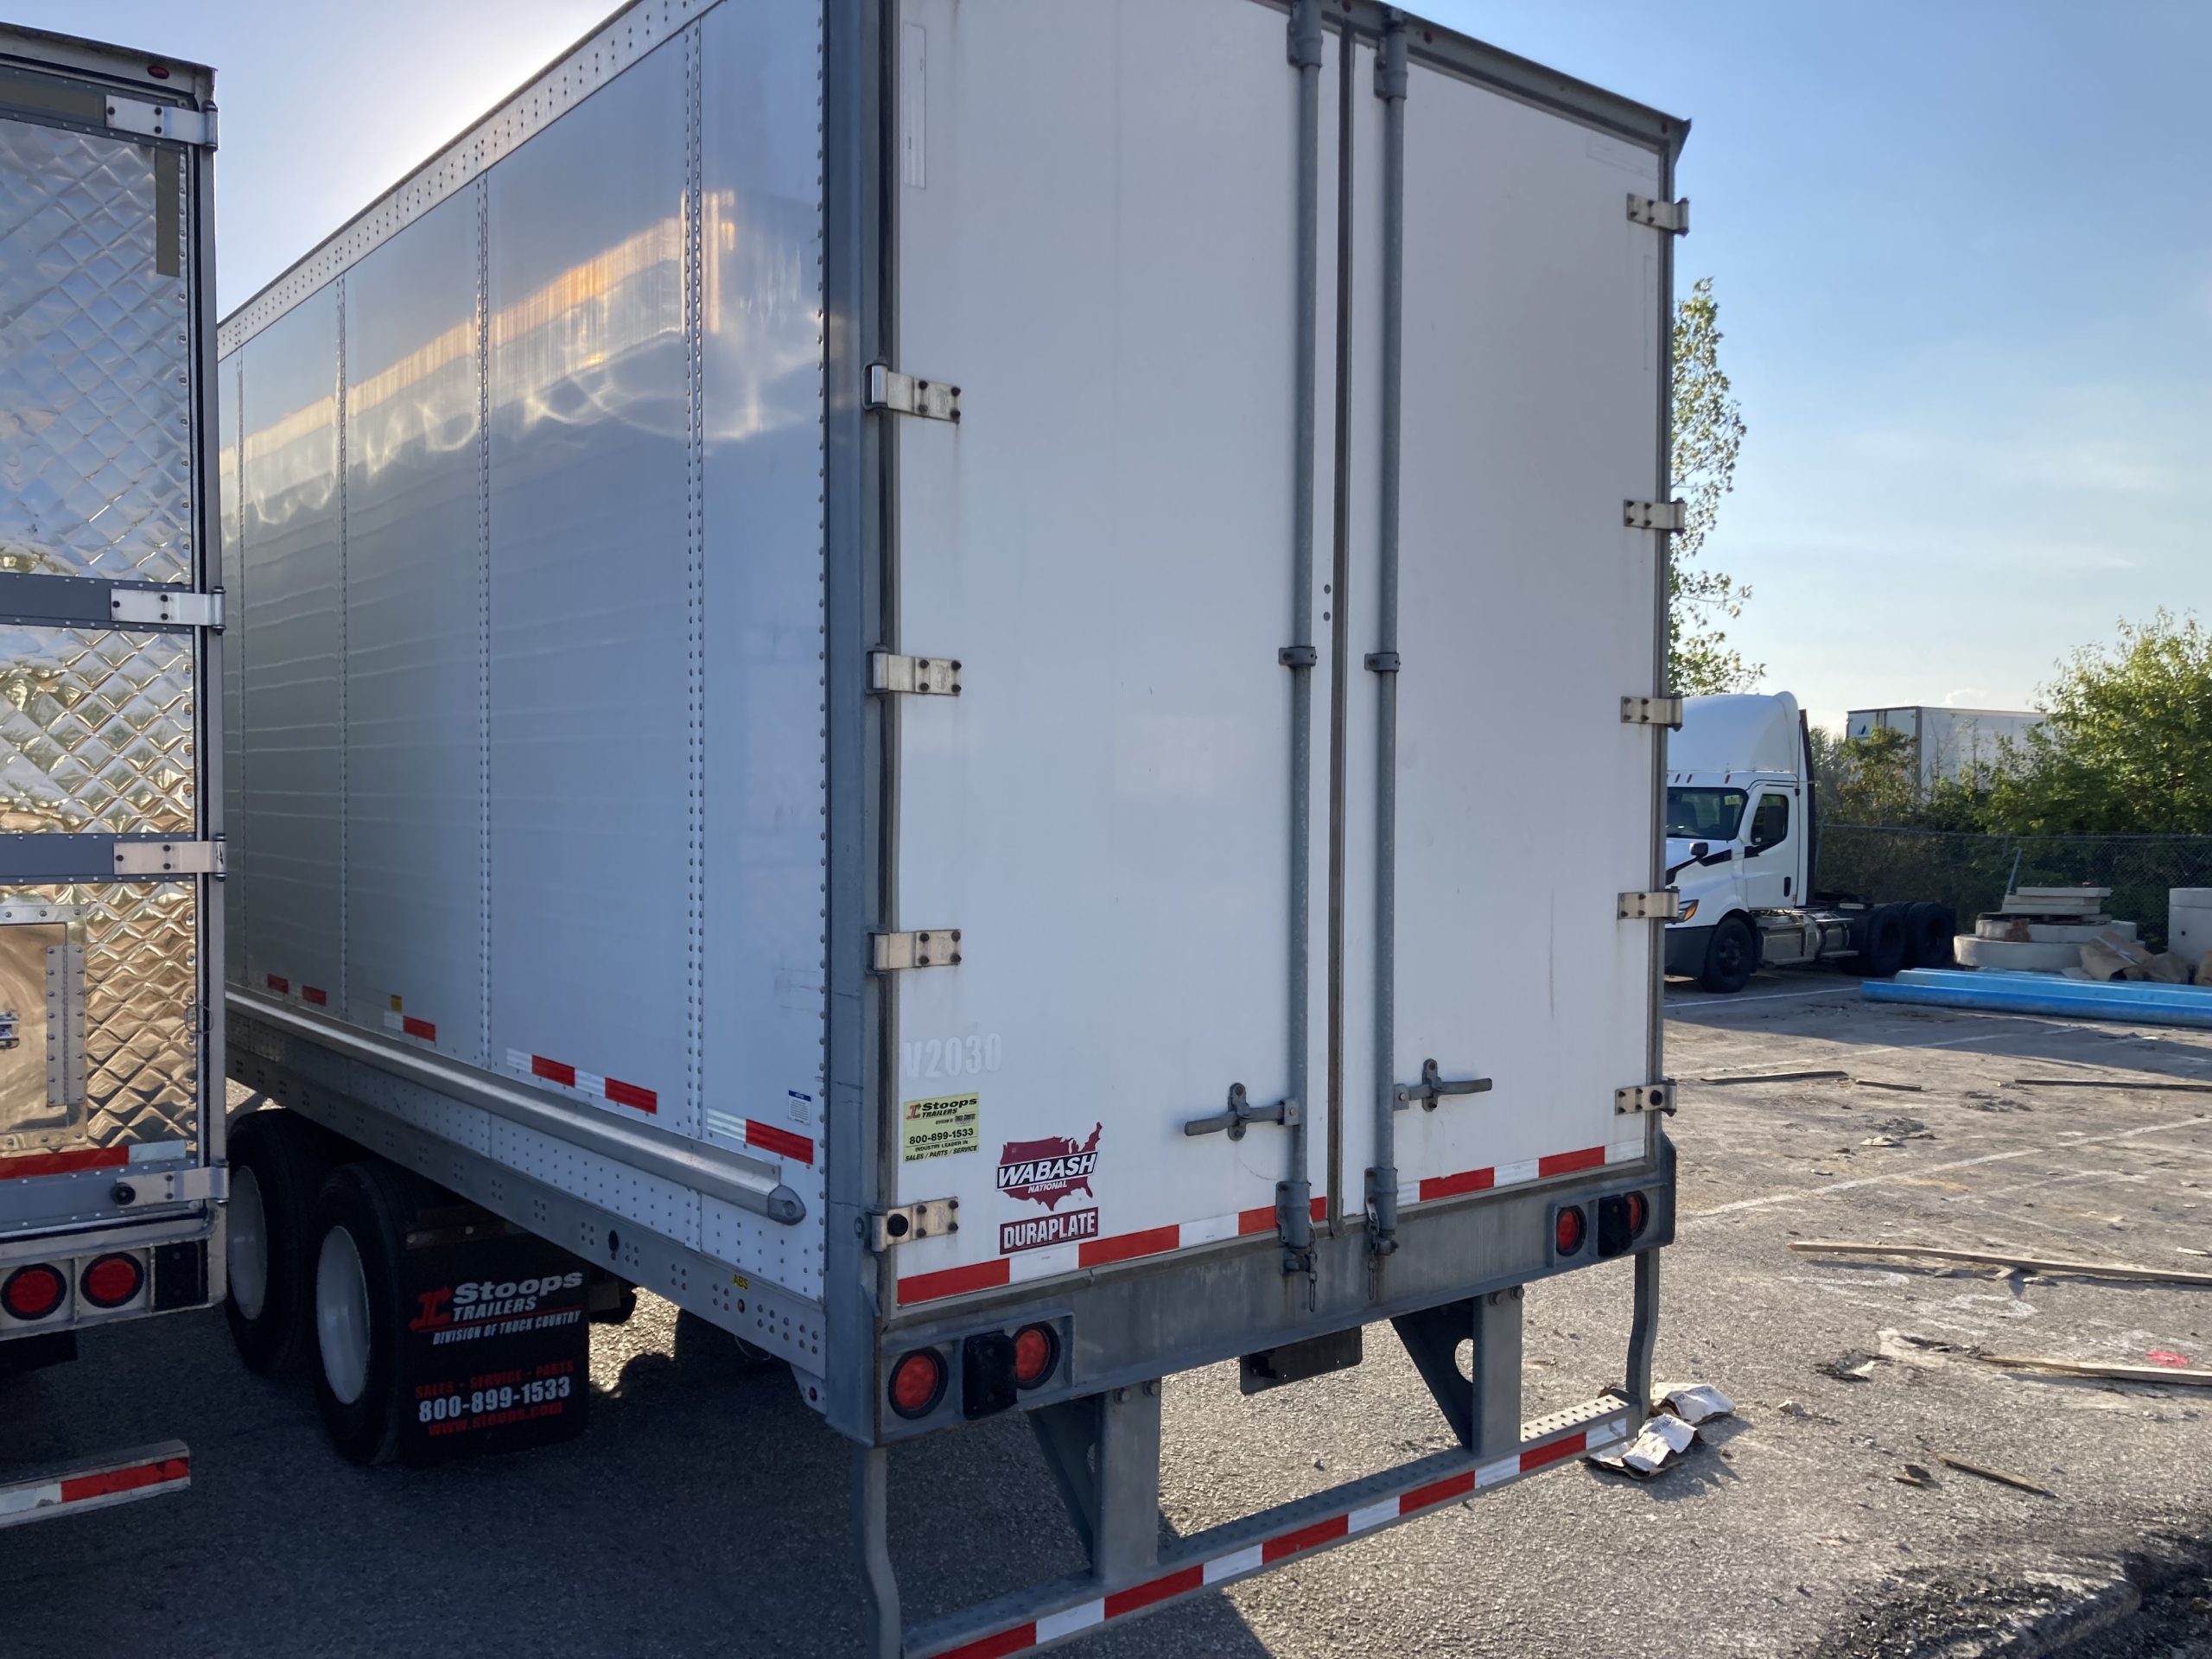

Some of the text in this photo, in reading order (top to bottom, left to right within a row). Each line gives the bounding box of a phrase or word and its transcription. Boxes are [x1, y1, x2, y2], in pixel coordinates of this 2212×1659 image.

[903, 1033, 1002, 1079] V2030
[921, 1098, 977, 1111] Stoops
[922, 1108, 958, 1118] TRAILERS
[909, 1128, 974, 1144] 800-899-1533
[905, 1153, 924, 1161] SALES
[952, 1145, 978, 1154] SERVICE
[998, 1154, 1096, 1187] WABASH
[1027, 1179, 1068, 1194] NATIONAL
[1003, 1211, 1096, 1249] DURAPLATE
[453, 1272, 583, 1305] Stoops
[734, 1274, 748, 1290] ABS
[453, 1295, 537, 1322] TRAILERS
[432, 1310, 582, 1345] DIVISION OF TRUCK COUNTRY
[415, 1360, 575, 1399] SALES SERVICE PARTS
[418, 1376, 571, 1423] 800-899-1533
